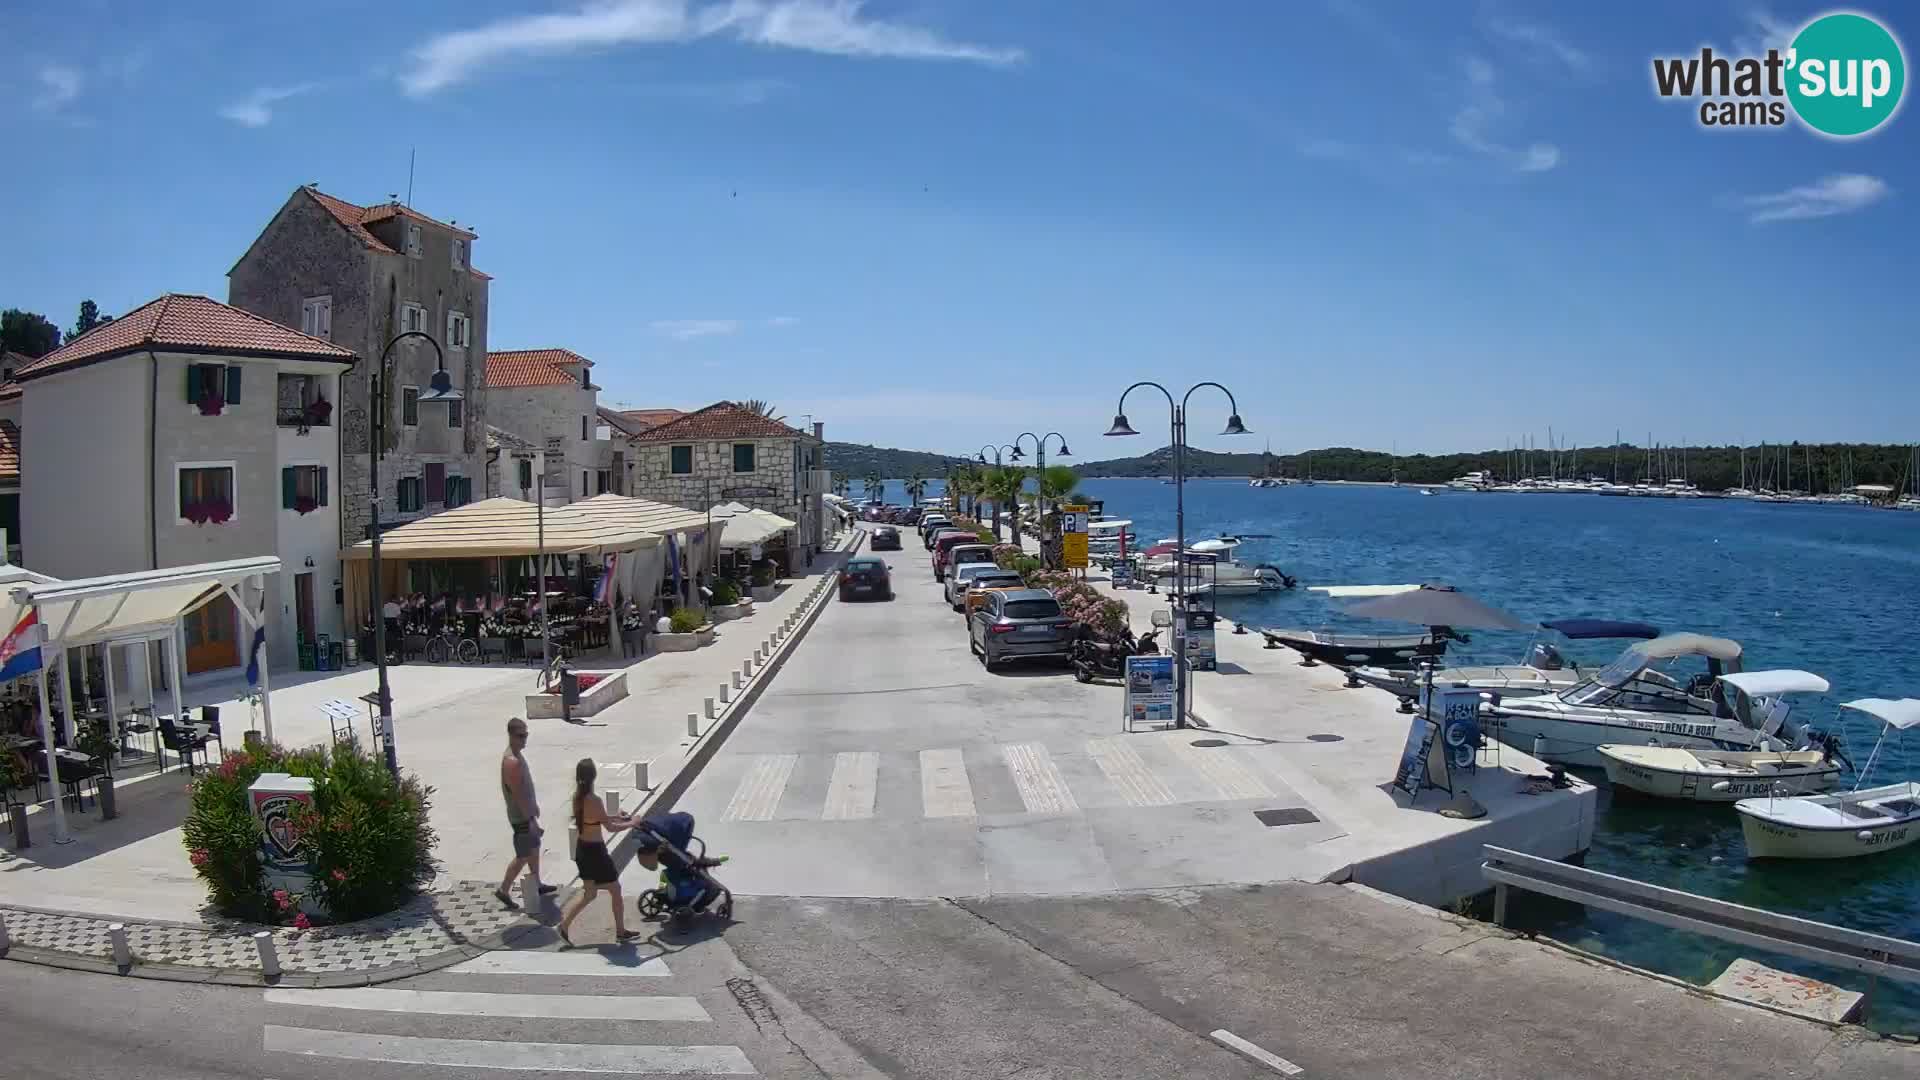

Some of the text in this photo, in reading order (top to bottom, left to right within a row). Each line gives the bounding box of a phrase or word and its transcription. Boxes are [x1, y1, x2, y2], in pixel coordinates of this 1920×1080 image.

[1665, 722, 1687, 734] RENT
[1688, 724, 1694, 735] A
[1695, 725, 1717, 737] BOAT
[1725, 783, 1774, 794] ENT A BOAT
